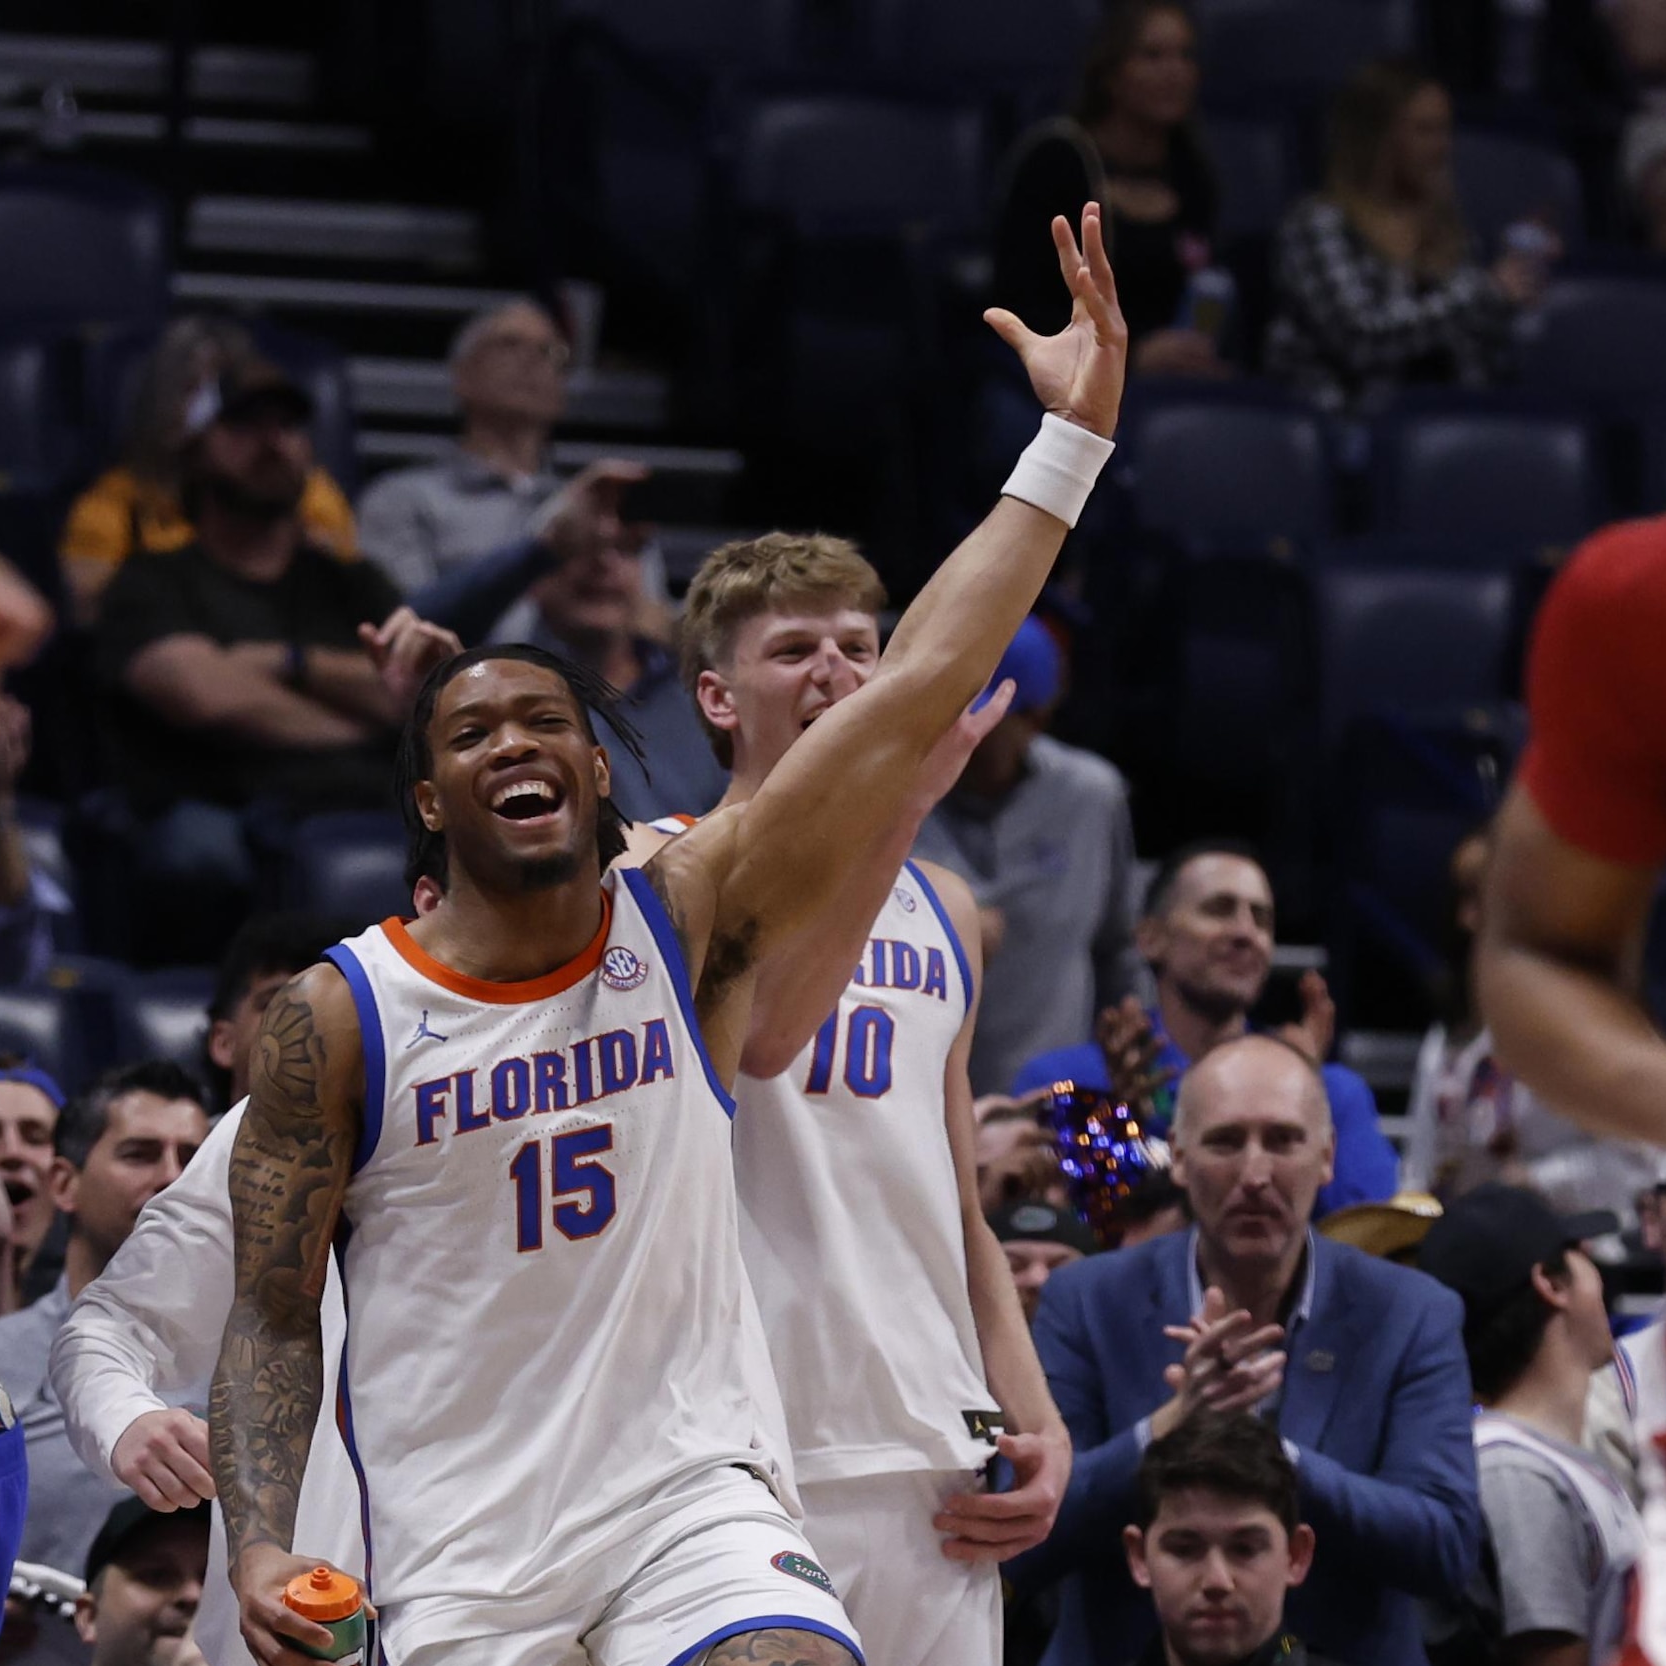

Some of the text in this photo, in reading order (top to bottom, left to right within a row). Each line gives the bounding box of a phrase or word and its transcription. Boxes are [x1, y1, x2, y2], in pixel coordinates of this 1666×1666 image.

[605, 948, 637, 978] SEC
[412, 1018, 674, 1147] FLORIDA
[804, 1003, 895, 1098] 10
[510, 1123, 617, 1253] 15
